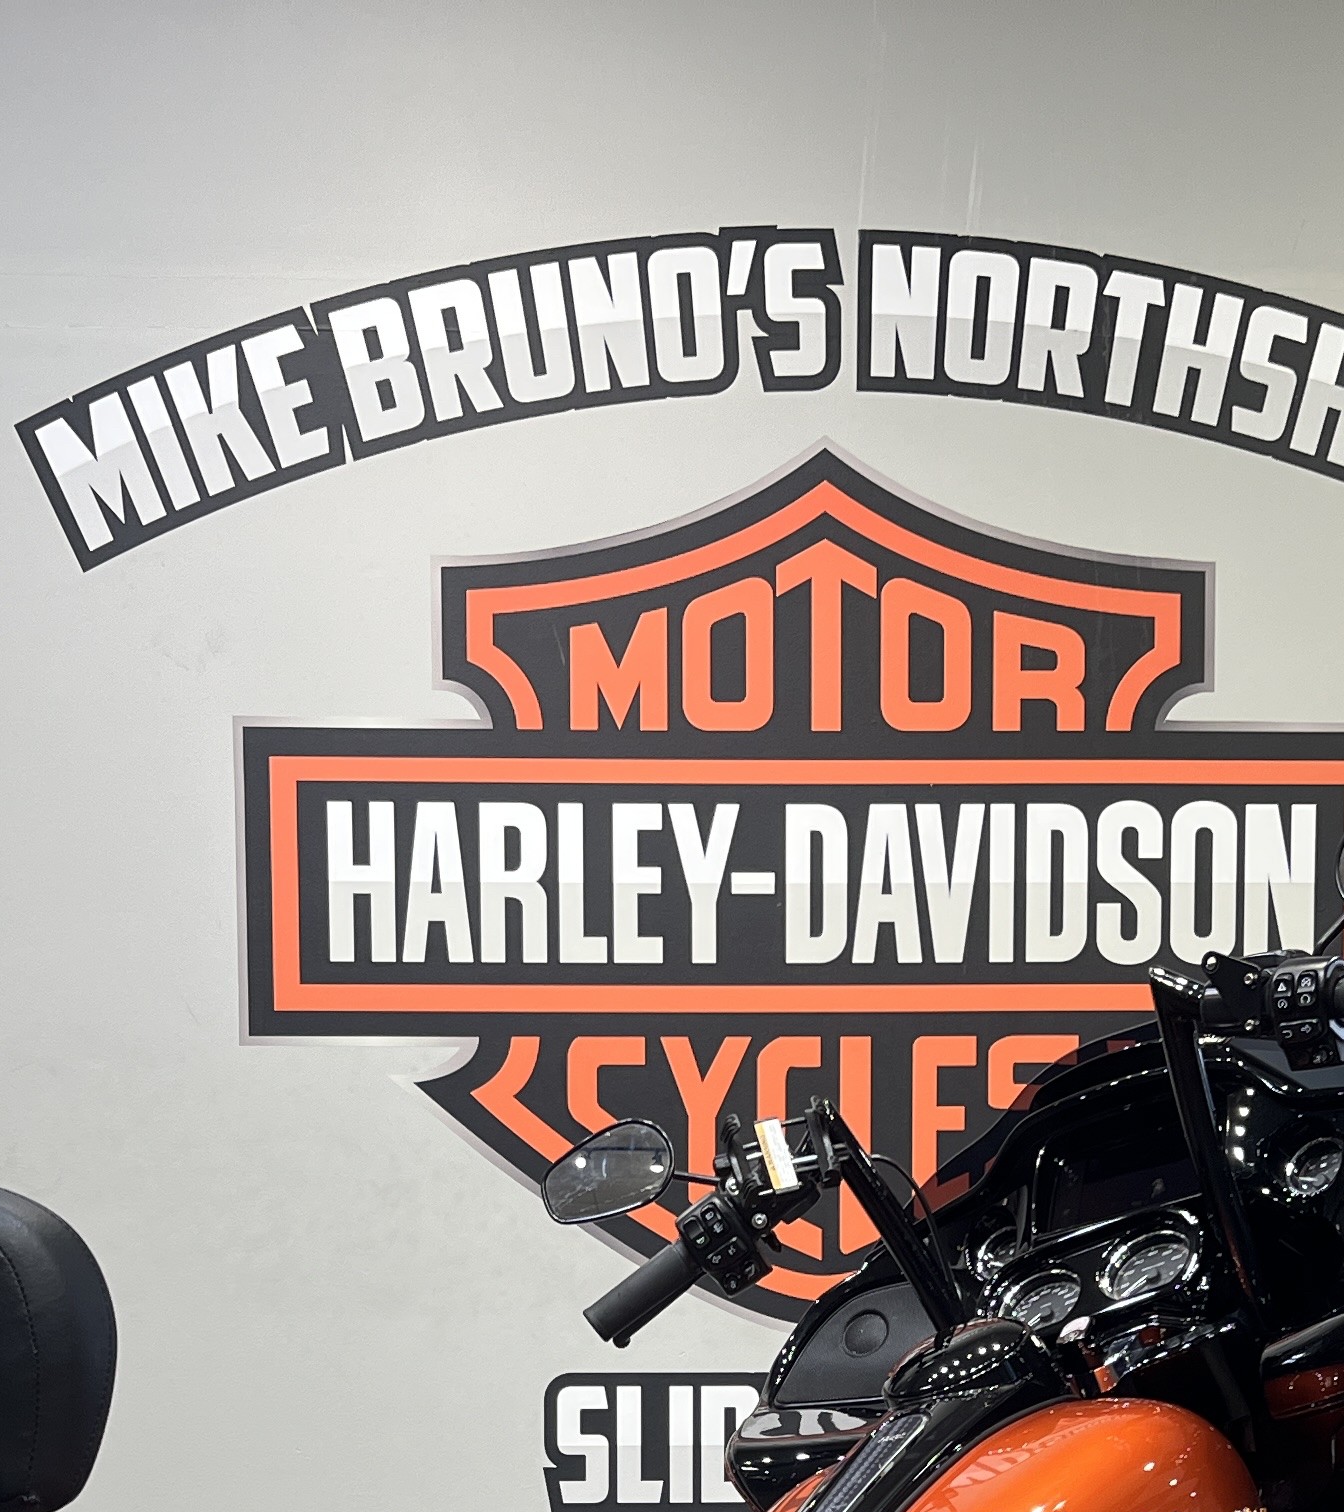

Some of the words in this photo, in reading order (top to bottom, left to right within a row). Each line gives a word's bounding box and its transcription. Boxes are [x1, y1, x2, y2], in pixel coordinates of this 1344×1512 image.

[35, 323, 330, 552] MIKE
[327, 240, 827, 443] BRUNO'S
[571, 539, 1085, 732] MOTOR
[326, 799, 1318, 966] HARLEY-DAVIDSON
